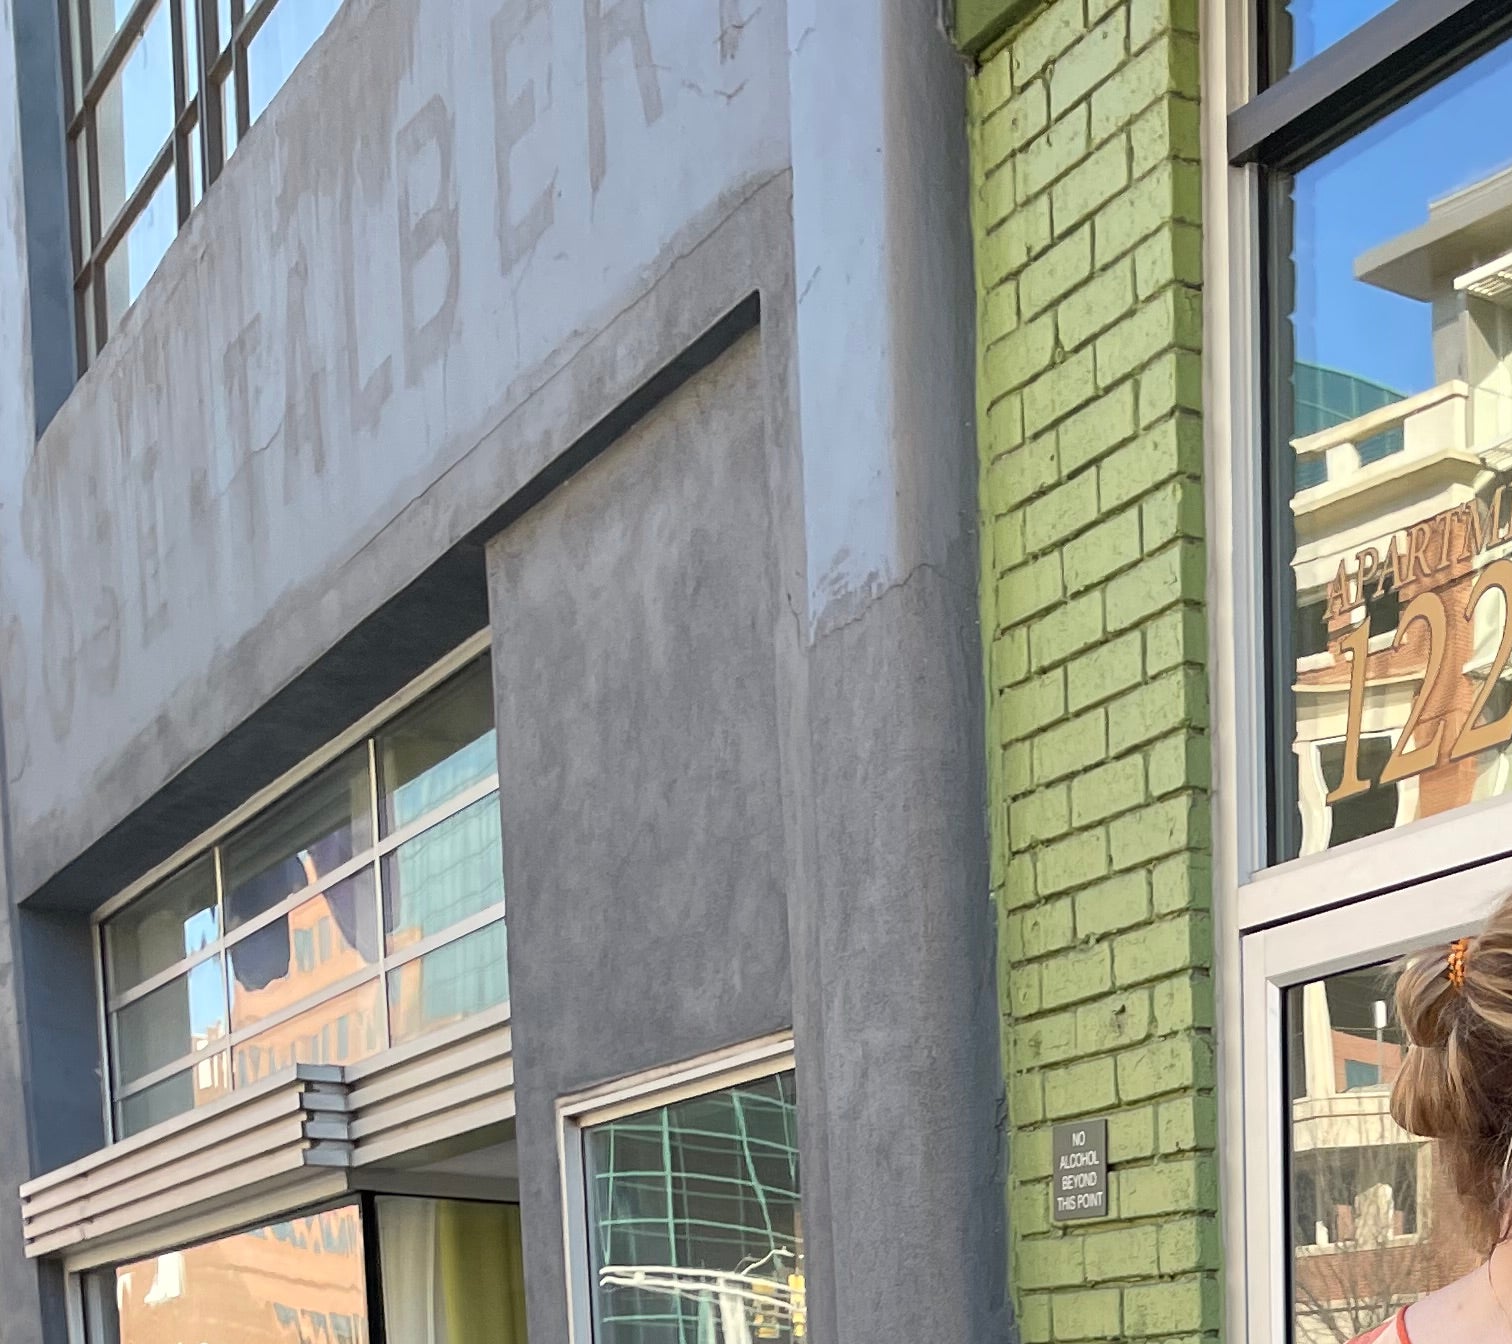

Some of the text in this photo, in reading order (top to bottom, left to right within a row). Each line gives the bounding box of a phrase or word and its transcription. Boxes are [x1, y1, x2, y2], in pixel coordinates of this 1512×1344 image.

[1072, 1130, 1086, 1146] NO
[1060, 1150, 1100, 1170] ALCOHOL
[1061, 1171, 1097, 1190] BEYOND
[1056, 1191, 1104, 1211] THIS POINT
